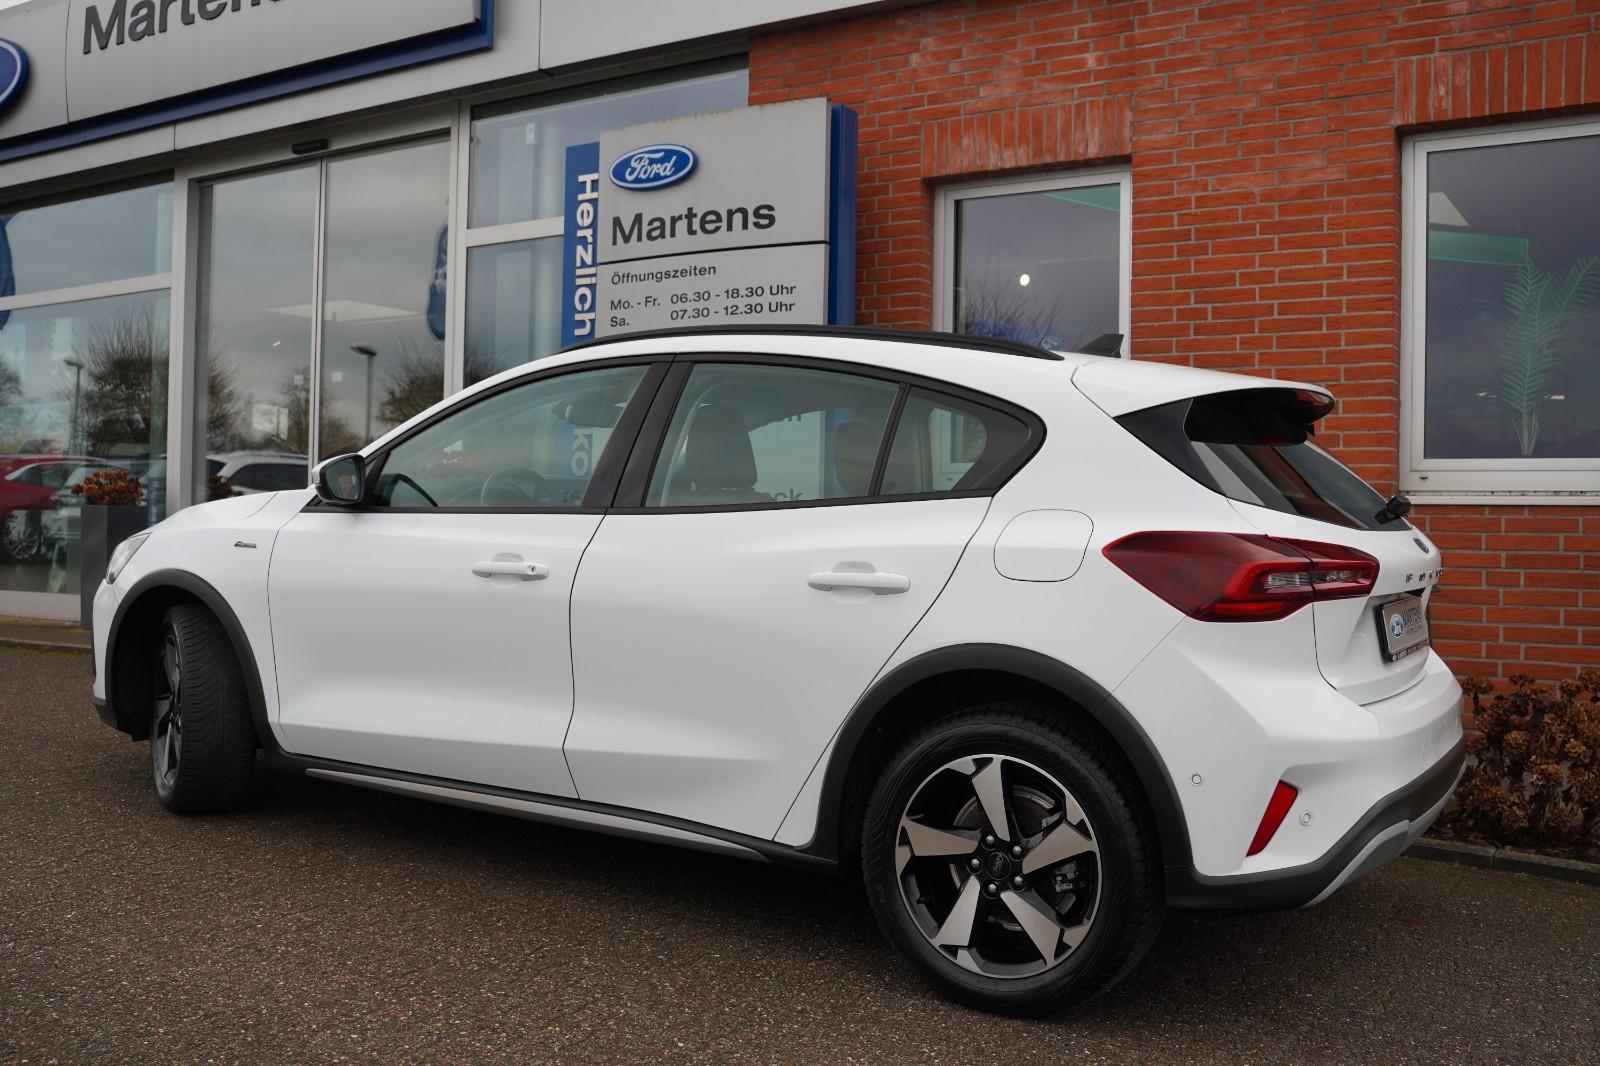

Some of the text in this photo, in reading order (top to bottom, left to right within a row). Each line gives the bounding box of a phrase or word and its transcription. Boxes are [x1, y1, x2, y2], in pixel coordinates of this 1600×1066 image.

[625, 152, 676, 181] Ford
[611, 203, 777, 246] Martens
[574, 172, 599, 337] Herzlich
[611, 264, 717, 285] Öffnungszeiten
[610, 298, 634, 311] Mo.
[644, 295, 661, 308] Fr.
[670, 291, 711, 305] 06.30
[724, 286, 765, 300] 18.30
[769, 284, 797, 297] Uhr
[610, 315, 630, 328] Sa.
[670, 307, 710, 321] 07.30
[723, 302, 764, 316] 12.30
[768, 301, 796, 314] Uhr
